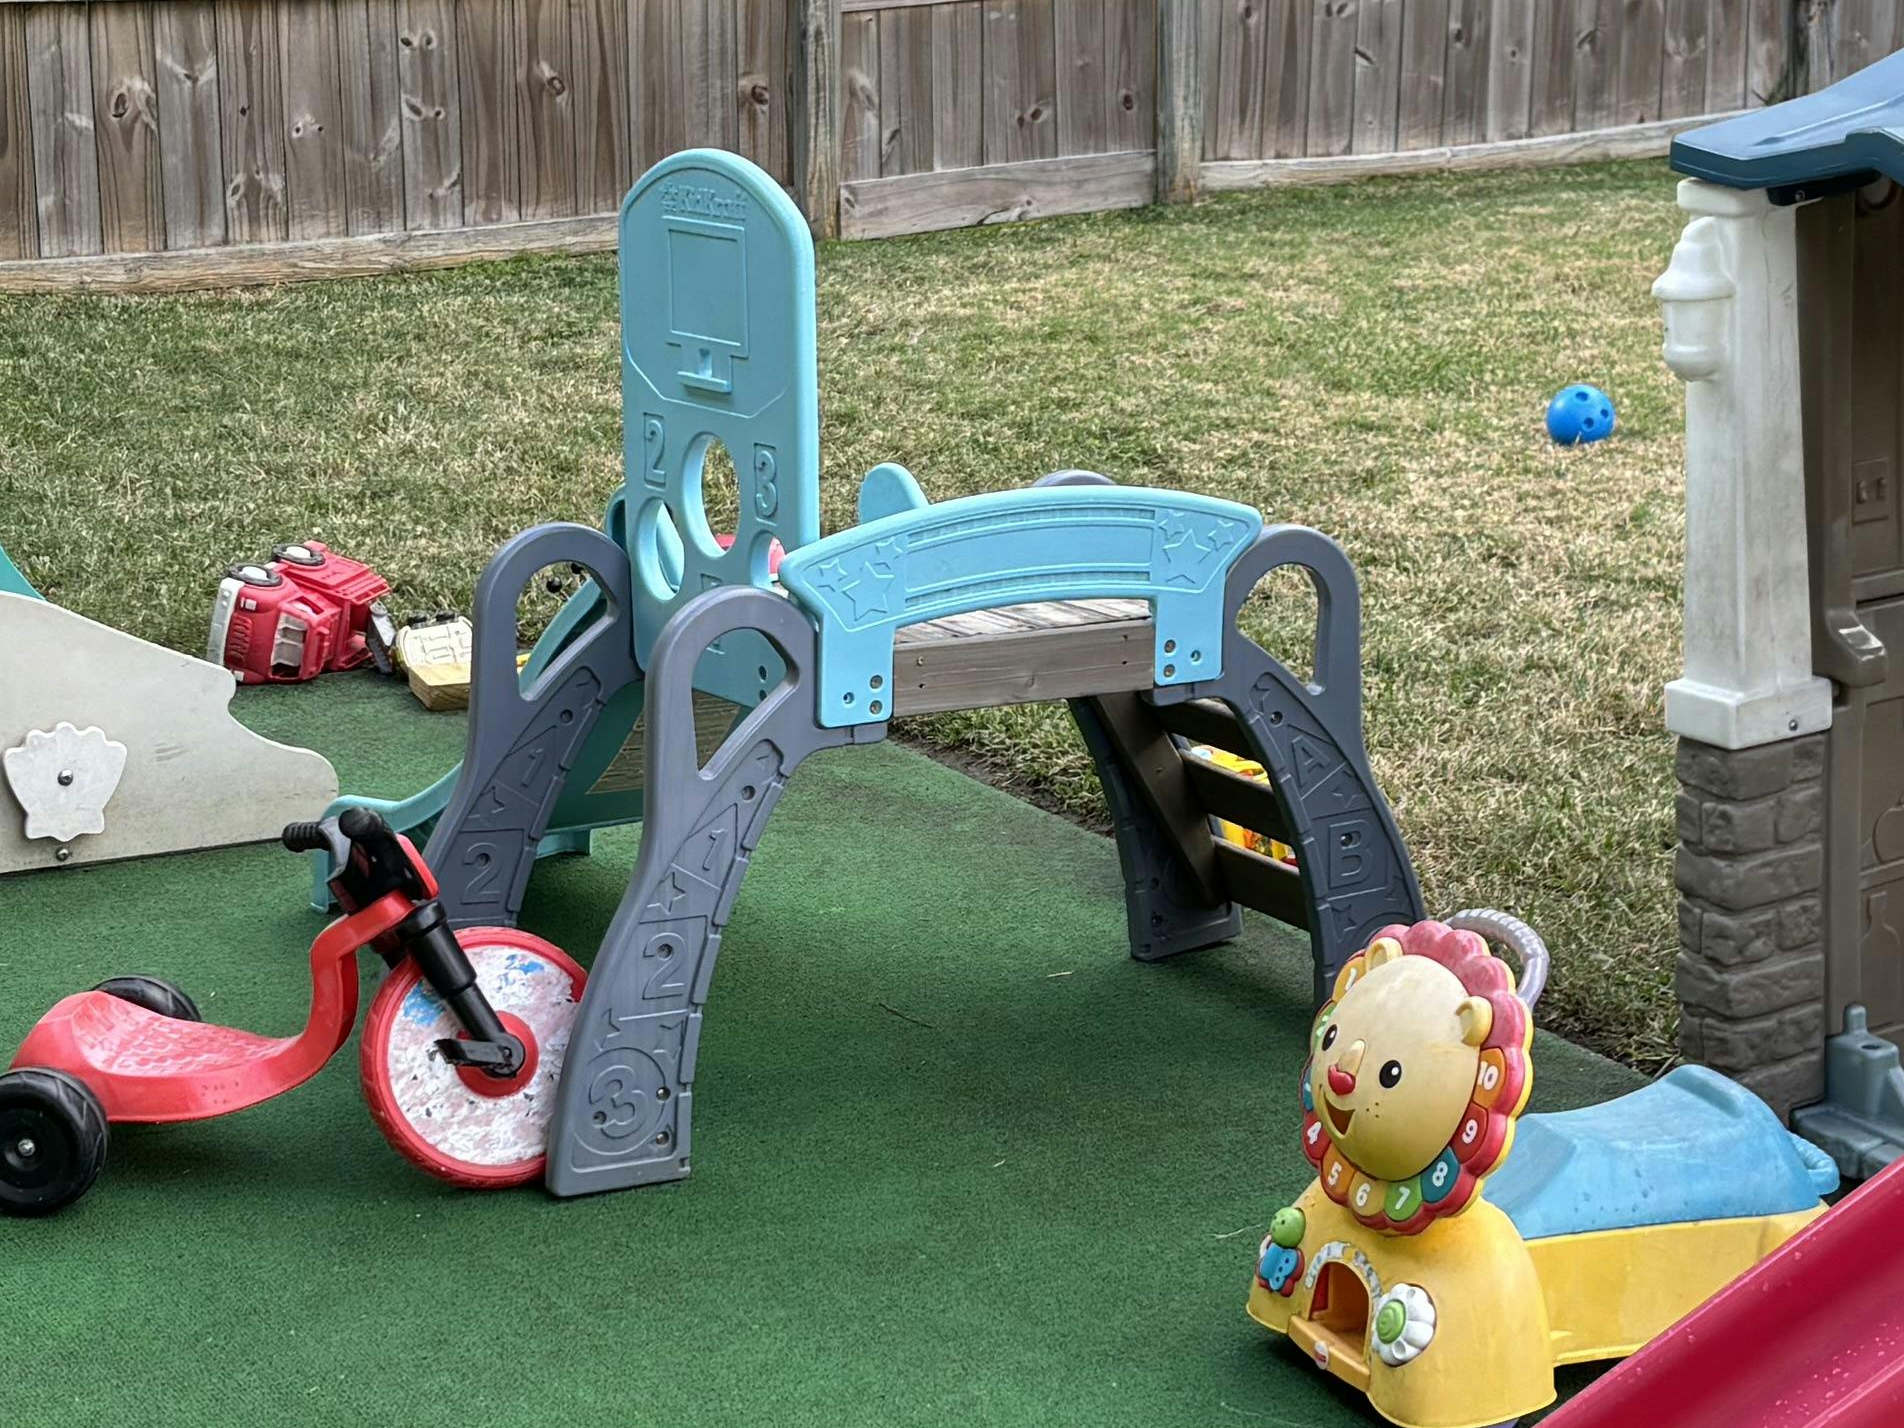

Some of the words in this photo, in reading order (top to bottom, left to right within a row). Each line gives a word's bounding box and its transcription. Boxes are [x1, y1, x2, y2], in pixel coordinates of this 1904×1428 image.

[644, 417, 667, 489] 2
[755, 447, 779, 518] 3
[521, 747, 545, 789] 1
[1291, 734, 1331, 788] A
[702, 828, 729, 872] 1
[1328, 819, 1374, 890] B
[460, 841, 502, 906] 2
[642, 932, 687, 1001] 2
[1476, 1060, 1499, 1091] 10
[588, 1064, 649, 1140] 3
[1306, 1121, 1322, 1145] 4
[1461, 1118, 1479, 1145] 9
[1327, 1161, 1343, 1187] 5
[1355, 1182, 1371, 1207] 6
[1431, 1160, 1449, 1188] 8
[1395, 1185, 1412, 1211] 7
